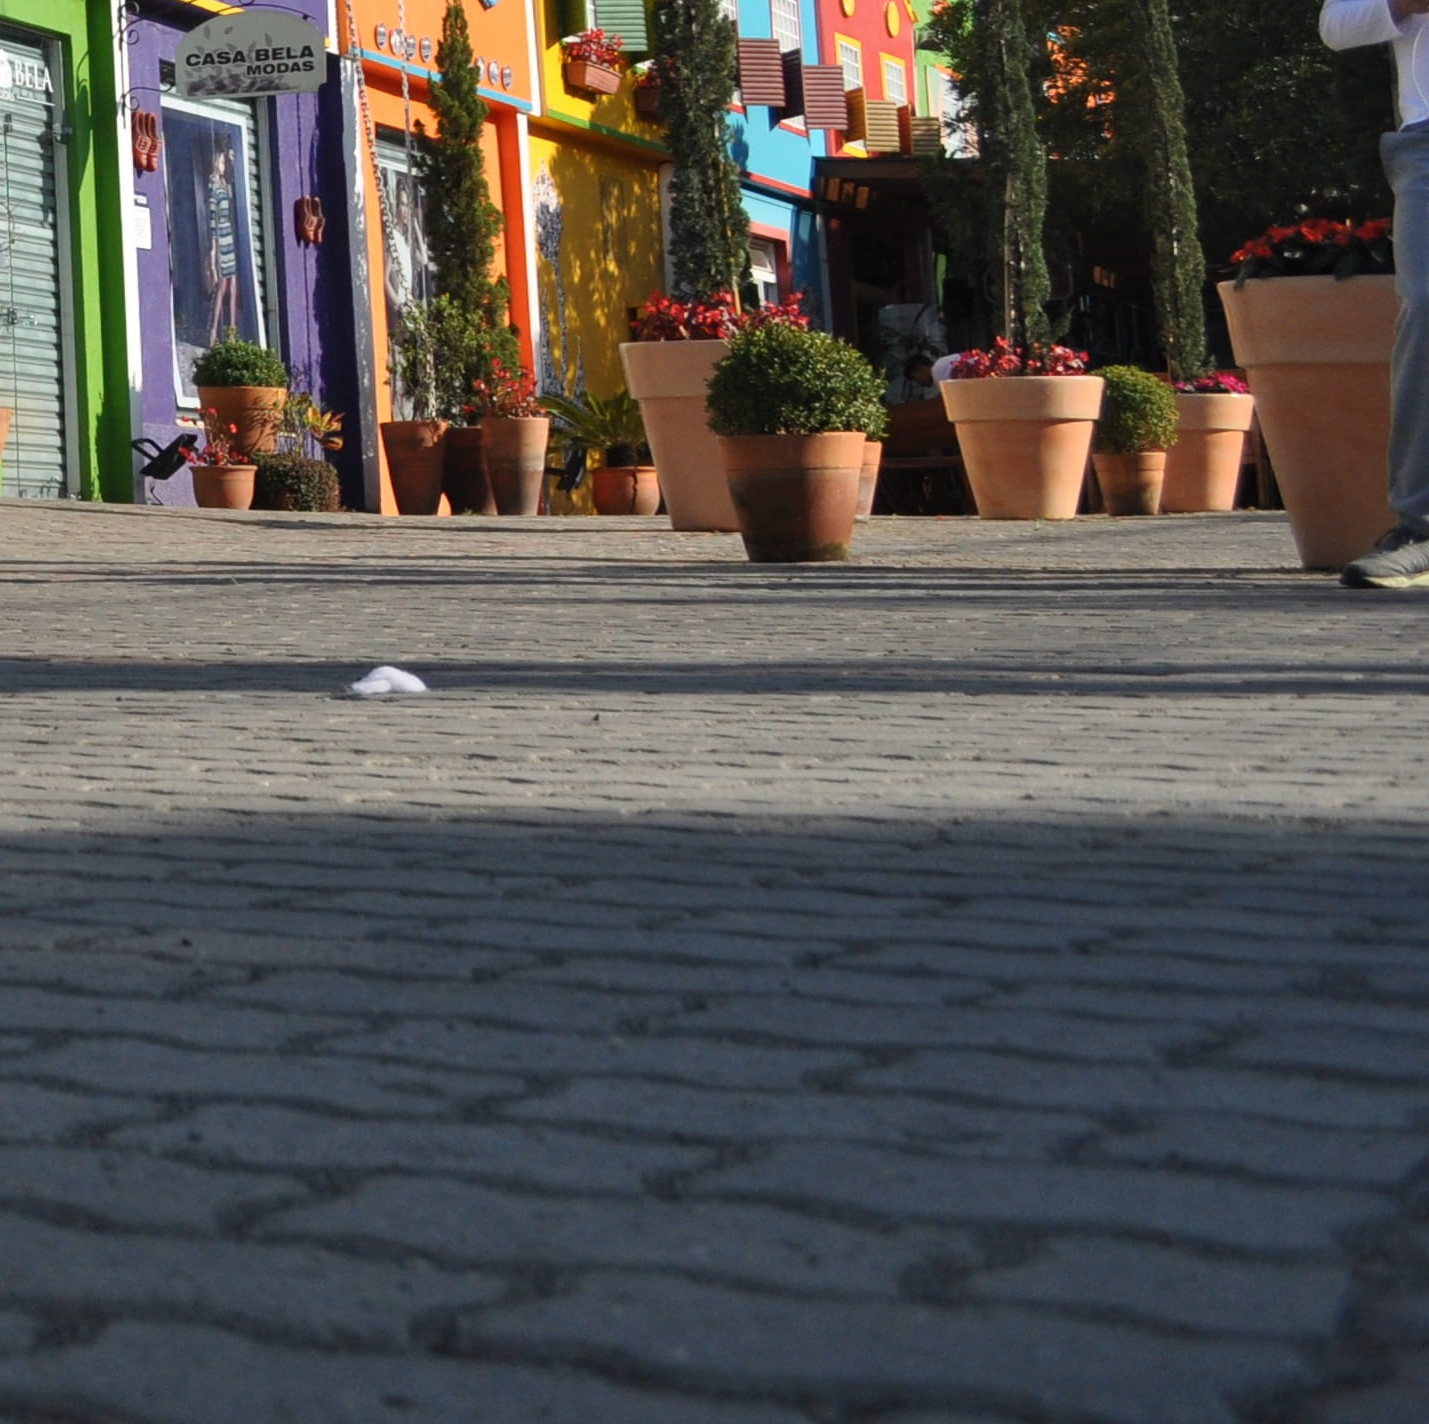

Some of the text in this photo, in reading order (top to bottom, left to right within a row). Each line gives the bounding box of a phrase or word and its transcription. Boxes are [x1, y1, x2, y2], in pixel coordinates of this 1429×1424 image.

[185, 45, 314, 67] CASA BELA
[11, 60, 54, 93] BELA
[246, 60, 315, 76] MODAS
